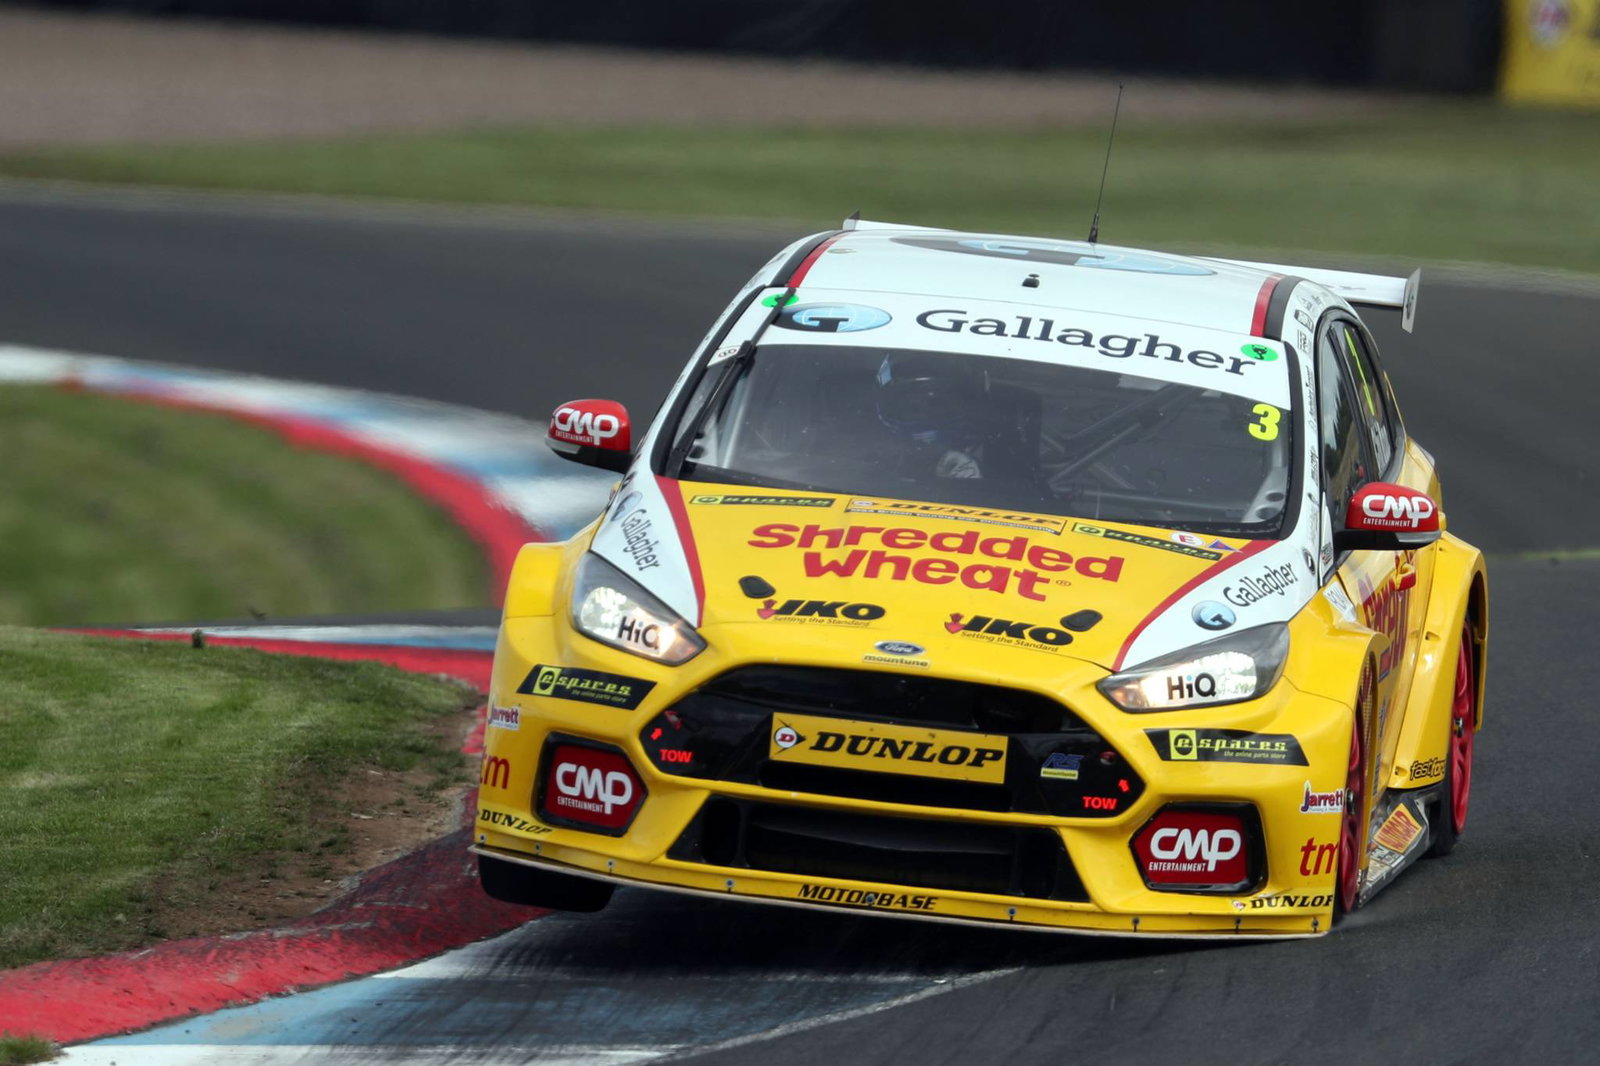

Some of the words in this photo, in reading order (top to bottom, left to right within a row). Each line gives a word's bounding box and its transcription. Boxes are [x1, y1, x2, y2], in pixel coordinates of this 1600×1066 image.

[916, 309, 1255, 375] Gallagher
[555, 407, 619, 446] CMP
[1248, 403, 1281, 441] 3
[889, 503, 1062, 525] DUNLOP
[1362, 494, 1433, 528] CMP
[1363, 517, 1411, 527] ENTERTAINMENT
[621, 509, 661, 571] Gallagher
[748, 523, 1124, 582] Shredded
[803, 549, 1050, 601] Wheat
[1222, 562, 1299, 607] Gallagher
[772, 600, 886, 620] IKO
[773, 616, 806, 624] Setting
[961, 631, 995, 643] Setting
[998, 637, 1014, 645] the
[1015, 638, 1060, 653] Standard
[963, 615, 1074, 646] IKO
[864, 655, 929, 667] mountune
[1166, 672, 1217, 701] HiQ
[660, 749, 693, 763] TOW
[809, 731, 1004, 768] DUNLOP
[556, 762, 633, 815] CMP
[1083, 796, 1117, 810] TOW
[557, 795, 604, 813] ENTERTAINMENT
[480, 809, 553, 834] DUNLOP
[1150, 827, 1242, 873] CMP
[1148, 861, 1207, 873] ENTERTAINMENT
[798, 883, 941, 911] MOTORBASE
